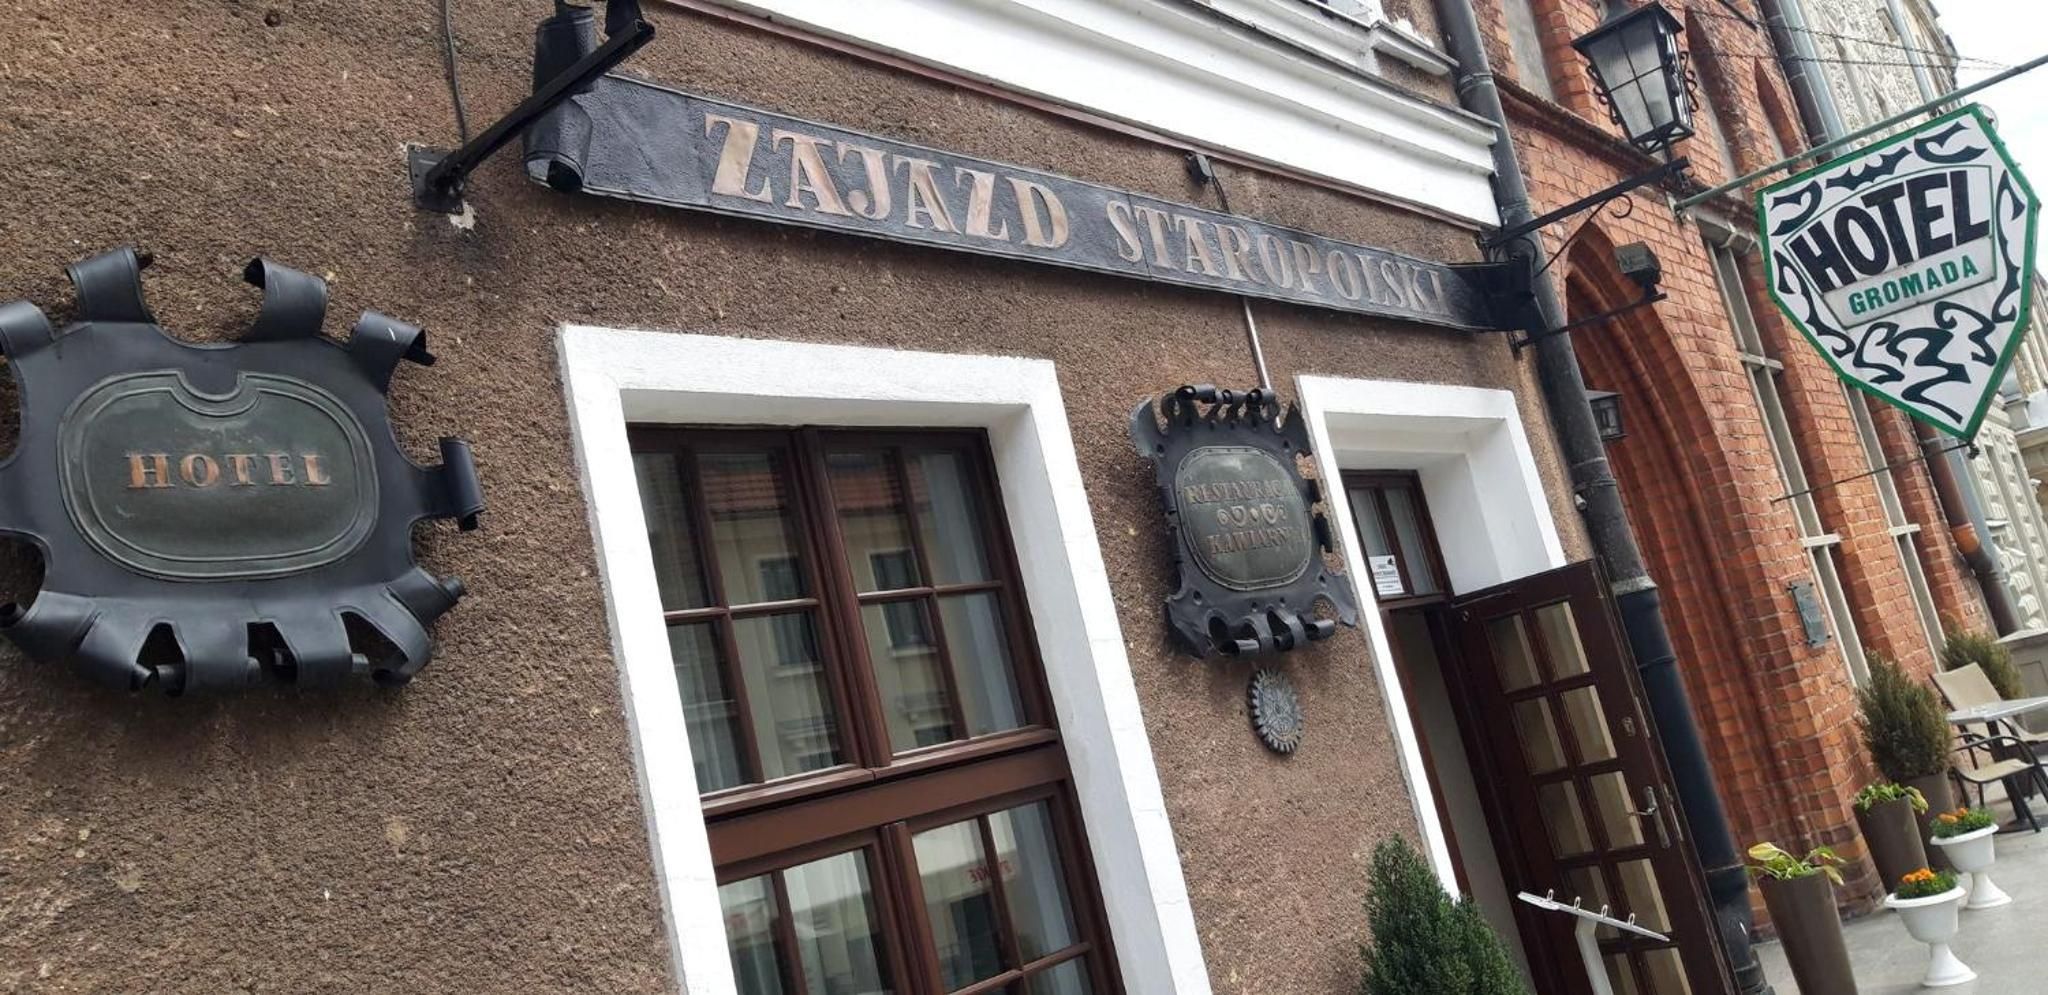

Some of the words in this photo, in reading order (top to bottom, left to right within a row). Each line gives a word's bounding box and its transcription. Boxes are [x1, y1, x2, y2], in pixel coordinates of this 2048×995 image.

[705, 113, 1070, 249] ZAJAZD
[1107, 199, 1454, 318] STAROPOLSKI
[1789, 169, 1990, 293] HOTEL
[1849, 254, 1978, 316] GROMADA
[124, 451, 332, 490] HOTEL
